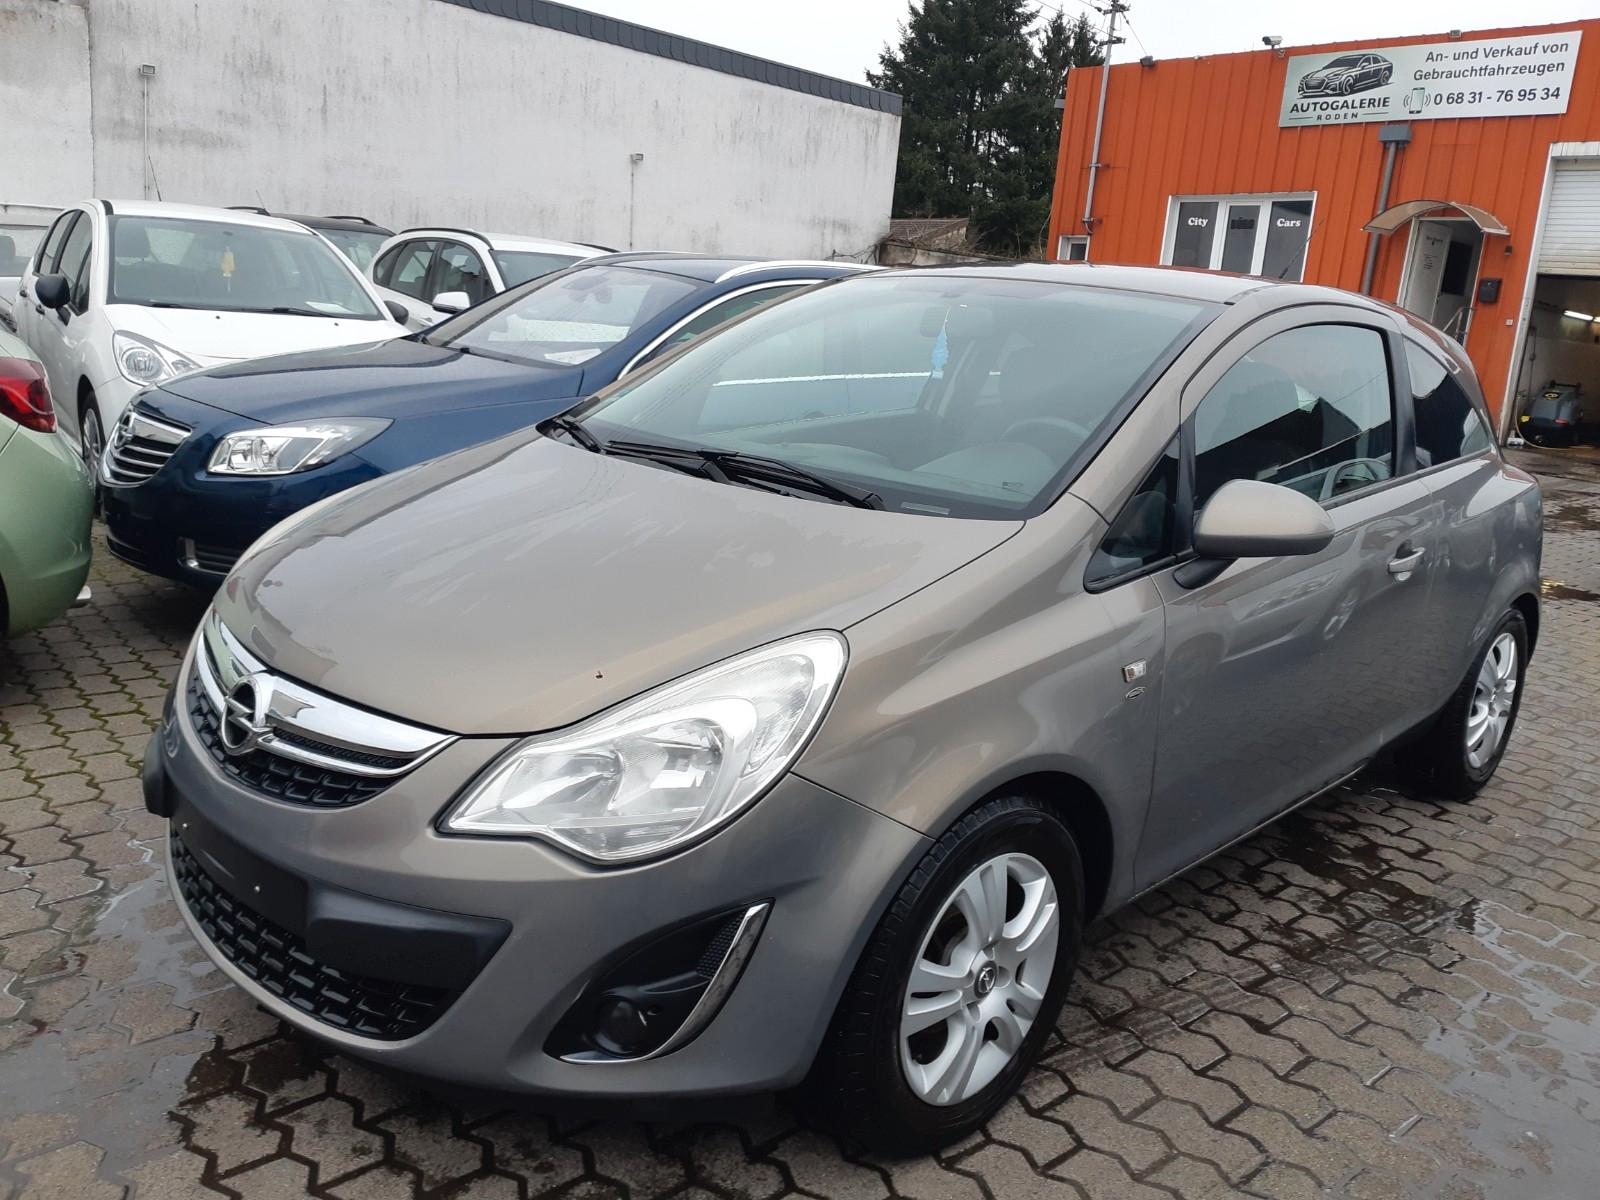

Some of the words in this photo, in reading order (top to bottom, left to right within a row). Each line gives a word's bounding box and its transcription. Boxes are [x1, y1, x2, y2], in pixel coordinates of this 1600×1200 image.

[1425, 51, 1449, 63] An-
[1453, 47, 1479, 61] und
[1483, 42, 1540, 58] Verkauf
[1542, 42, 1569, 53] von
[1413, 62, 1565, 81] Gebrauchtfahrzeugen
[1290, 97, 1390, 113] AUTOGALERIE
[1316, 112, 1358, 121] RODEN
[1188, 217, 1209, 228] City
[1276, 218, 1301, 227] Cars
